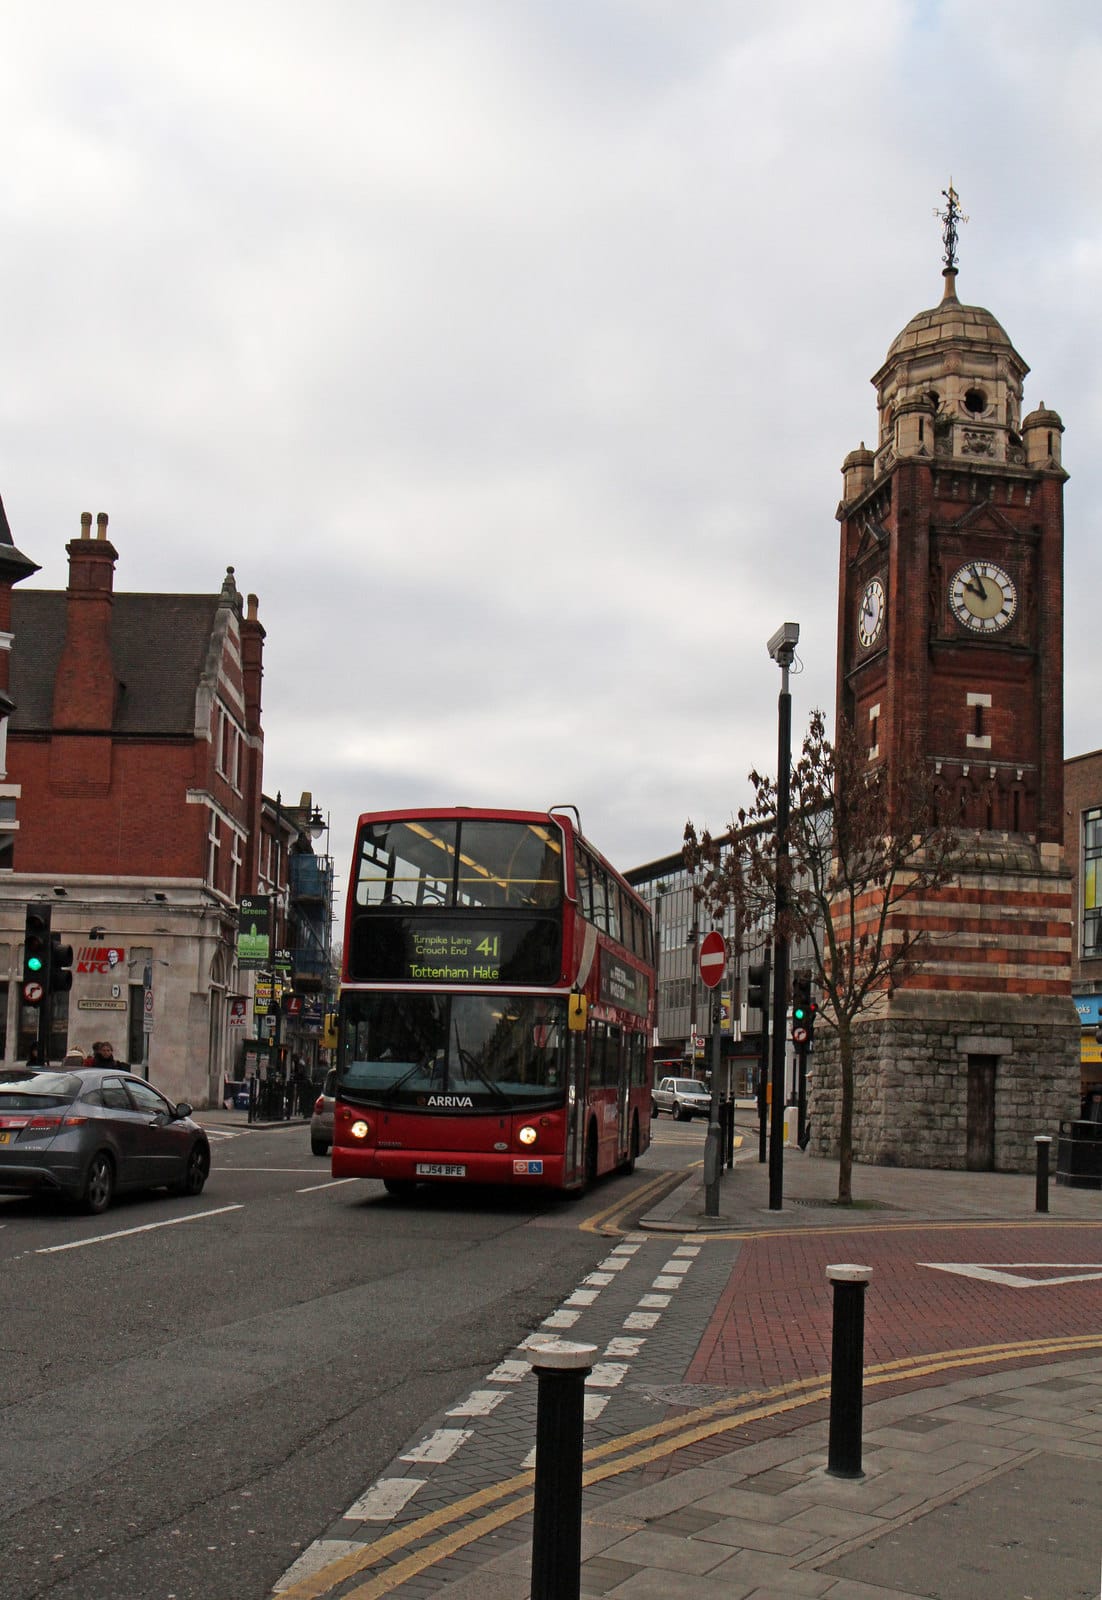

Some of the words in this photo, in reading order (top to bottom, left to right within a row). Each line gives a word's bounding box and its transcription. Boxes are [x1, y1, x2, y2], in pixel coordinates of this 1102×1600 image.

[241, 899, 252, 907] Go
[241, 907, 268, 915] Greene
[412, 934, 448, 945] Turnpike
[451, 936, 472, 944] Lane
[415, 946, 448, 954] Crouch
[450, 946, 468, 955] End
[475, 936, 499, 957] 41
[77, 962, 108, 973] KFC
[409, 964, 469, 978] Tottenham
[473, 965, 499, 979] Hale
[427, 1095, 473, 1108] ARRIVA
[420, 1165, 442, 1174] LJ54
[445, 1166, 462, 1175] BFE
